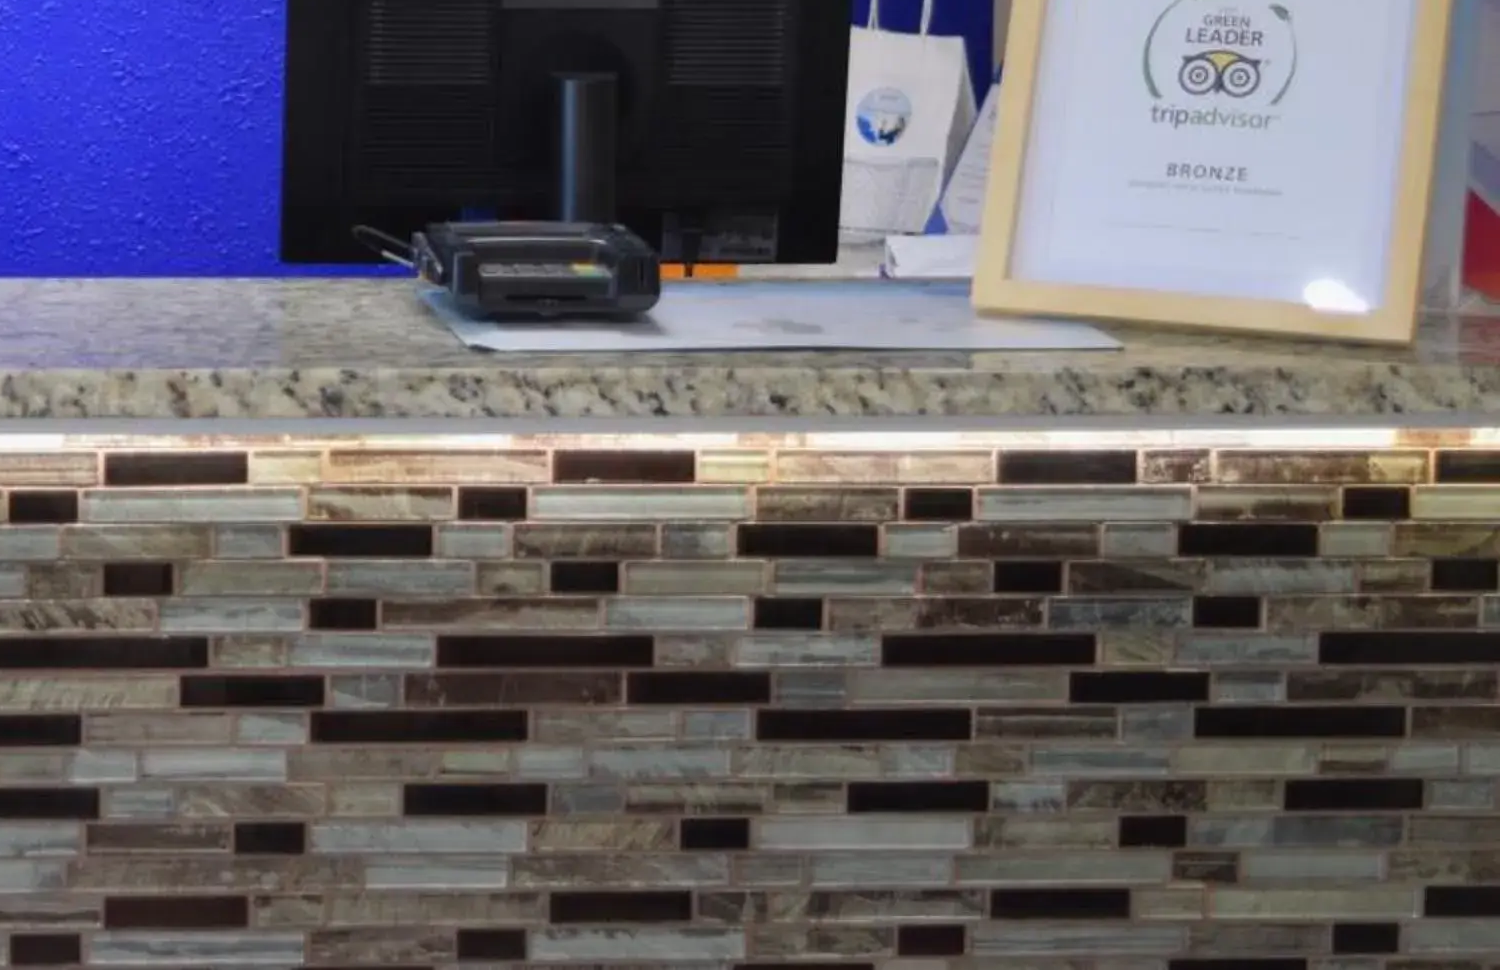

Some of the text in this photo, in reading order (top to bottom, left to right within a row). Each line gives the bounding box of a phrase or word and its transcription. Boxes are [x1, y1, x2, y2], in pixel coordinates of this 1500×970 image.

[1203, 15, 1251, 28] GREEN
[1186, 28, 1263, 46] LEADER
[1150, 103, 1273, 130] tripadvisor
[1166, 163, 1248, 182] BRONZE
